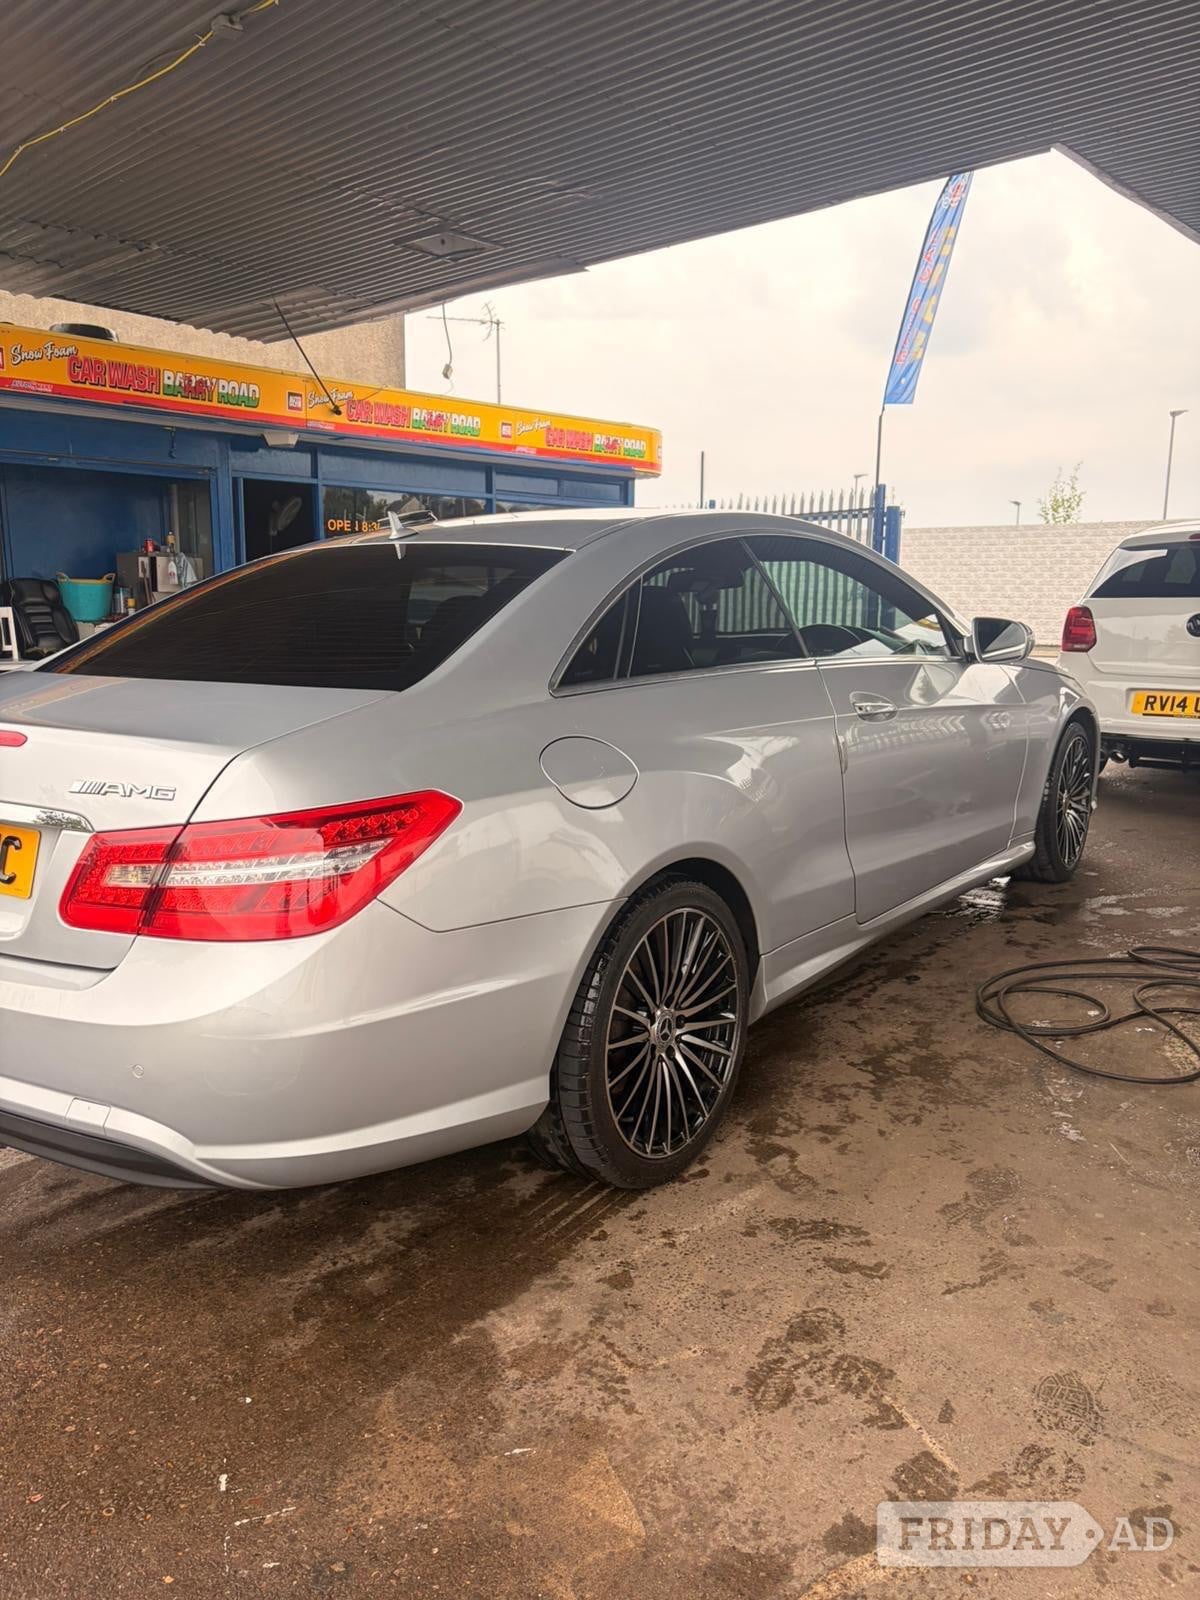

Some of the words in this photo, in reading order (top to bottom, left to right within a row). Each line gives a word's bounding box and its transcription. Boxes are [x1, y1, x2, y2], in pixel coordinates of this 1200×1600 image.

[10, 344, 44, 366] Snow
[44, 341, 78, 361] Foam
[67, 356, 107, 385] CAR
[108, 360, 160, 395] WASH
[163, 370, 217, 402] BARRY
[217, 380, 260, 408] ROAD
[331, 388, 354, 402] Foam
[346, 399, 373, 424] CAR
[374, 401, 411, 429] WASH
[450, 414, 481, 437] ROAD
[1143, 694, 1188, 712] RV14
[100, 782, 177, 801] AMG
